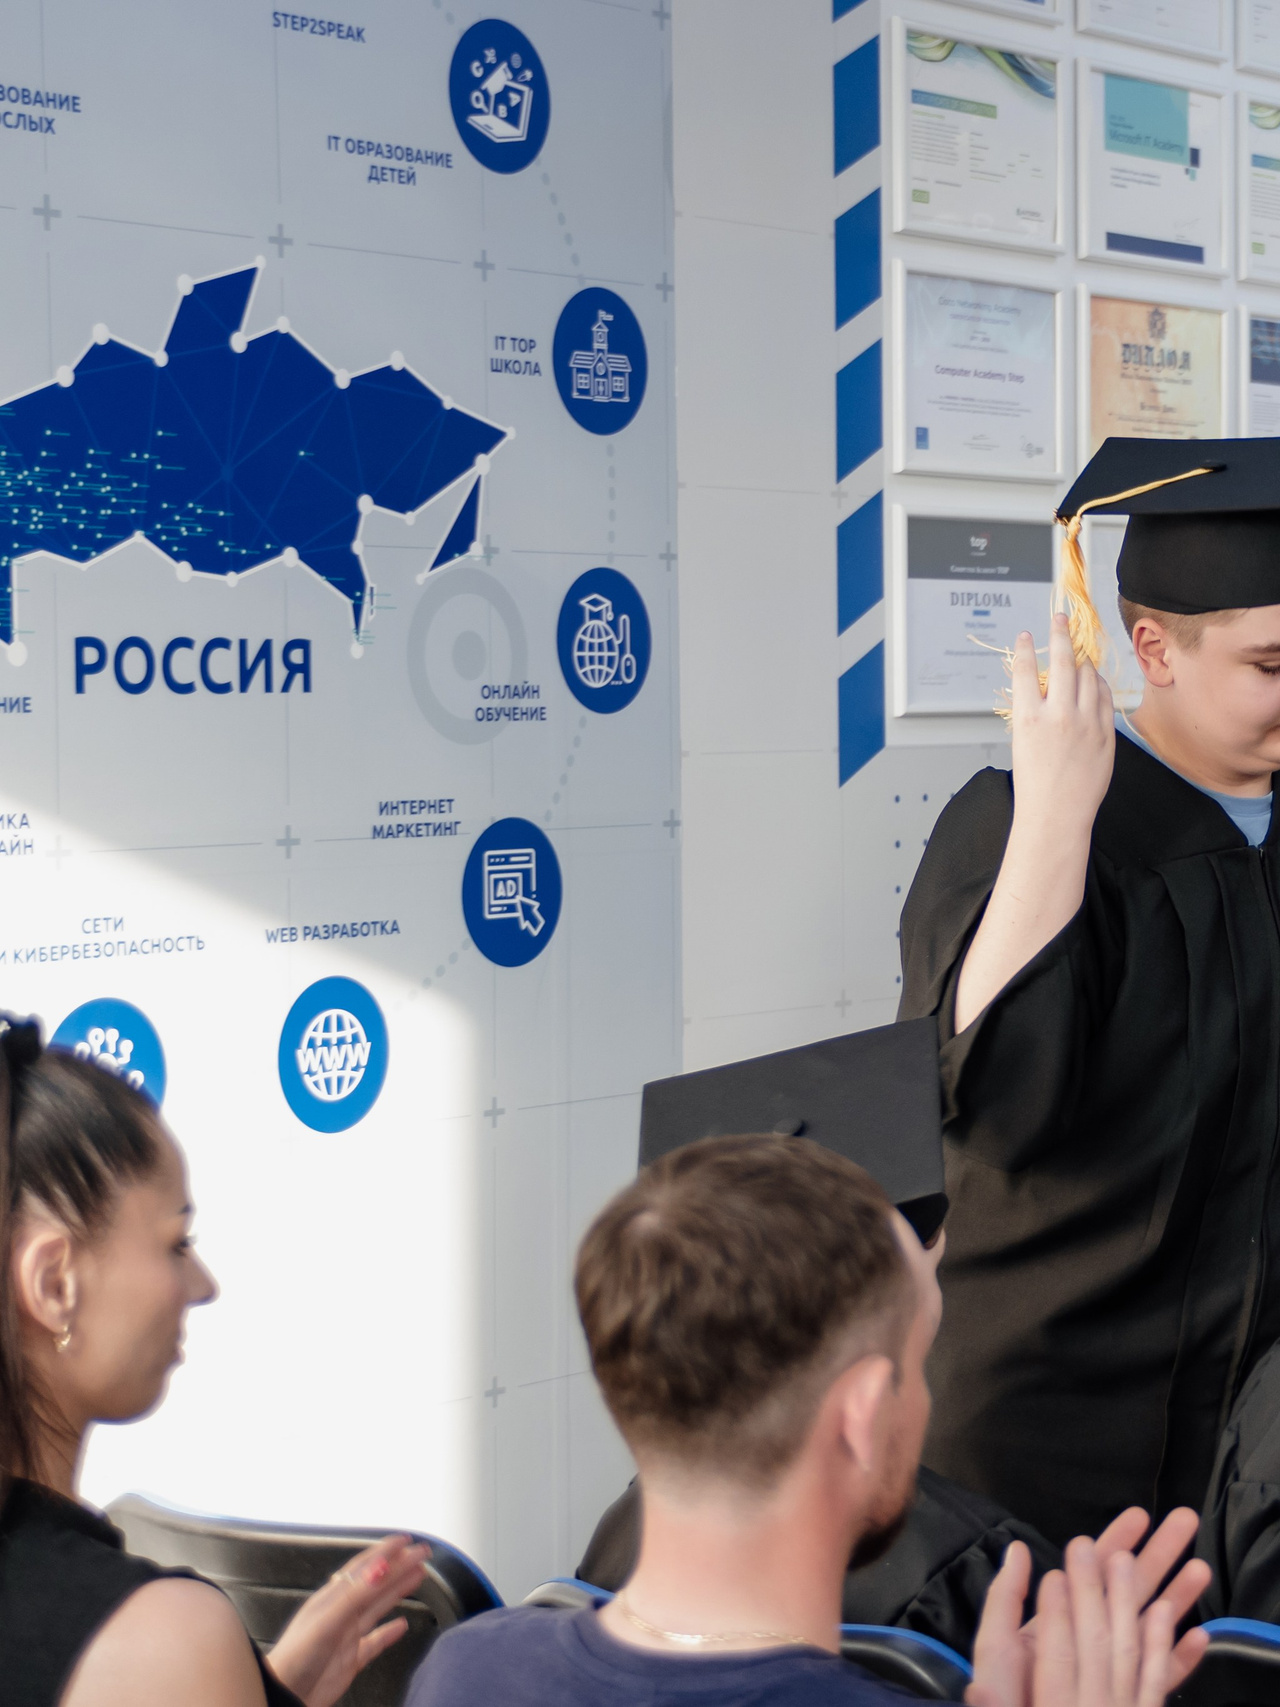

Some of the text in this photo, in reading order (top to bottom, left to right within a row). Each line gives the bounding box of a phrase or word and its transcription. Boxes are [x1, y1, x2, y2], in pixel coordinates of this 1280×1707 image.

[272, 11, 366, 43] STEP2SPEAK
[0, 111, 56, 135] СЛЫХ
[327, 135, 453, 168] IT ОБРАЗОВАНИЕ
[367, 165, 416, 186] ДЕТЕЙ
[494, 336, 537, 353] IT TOP
[490, 358, 542, 377] ШКОЛА
[949, 591, 1013, 608] DIPLOMA
[74, 636, 312, 695] РОССИЯ
[481, 681, 540, 700] ОНЛАЙН
[475, 706, 547, 722] ОБУЧЕНИЕ
[378, 798, 455, 817] ИНТЕРНЕТ
[372, 821, 462, 840] МАРКЕТИНГ
[496, 879, 517, 898] AD
[81, 916, 125, 934] СЕТИ
[265, 919, 401, 944] WEB РАЗРАБОТКА
[14, 935, 206, 964] КИБЕРБЕЗОПАСНОСТЬ
